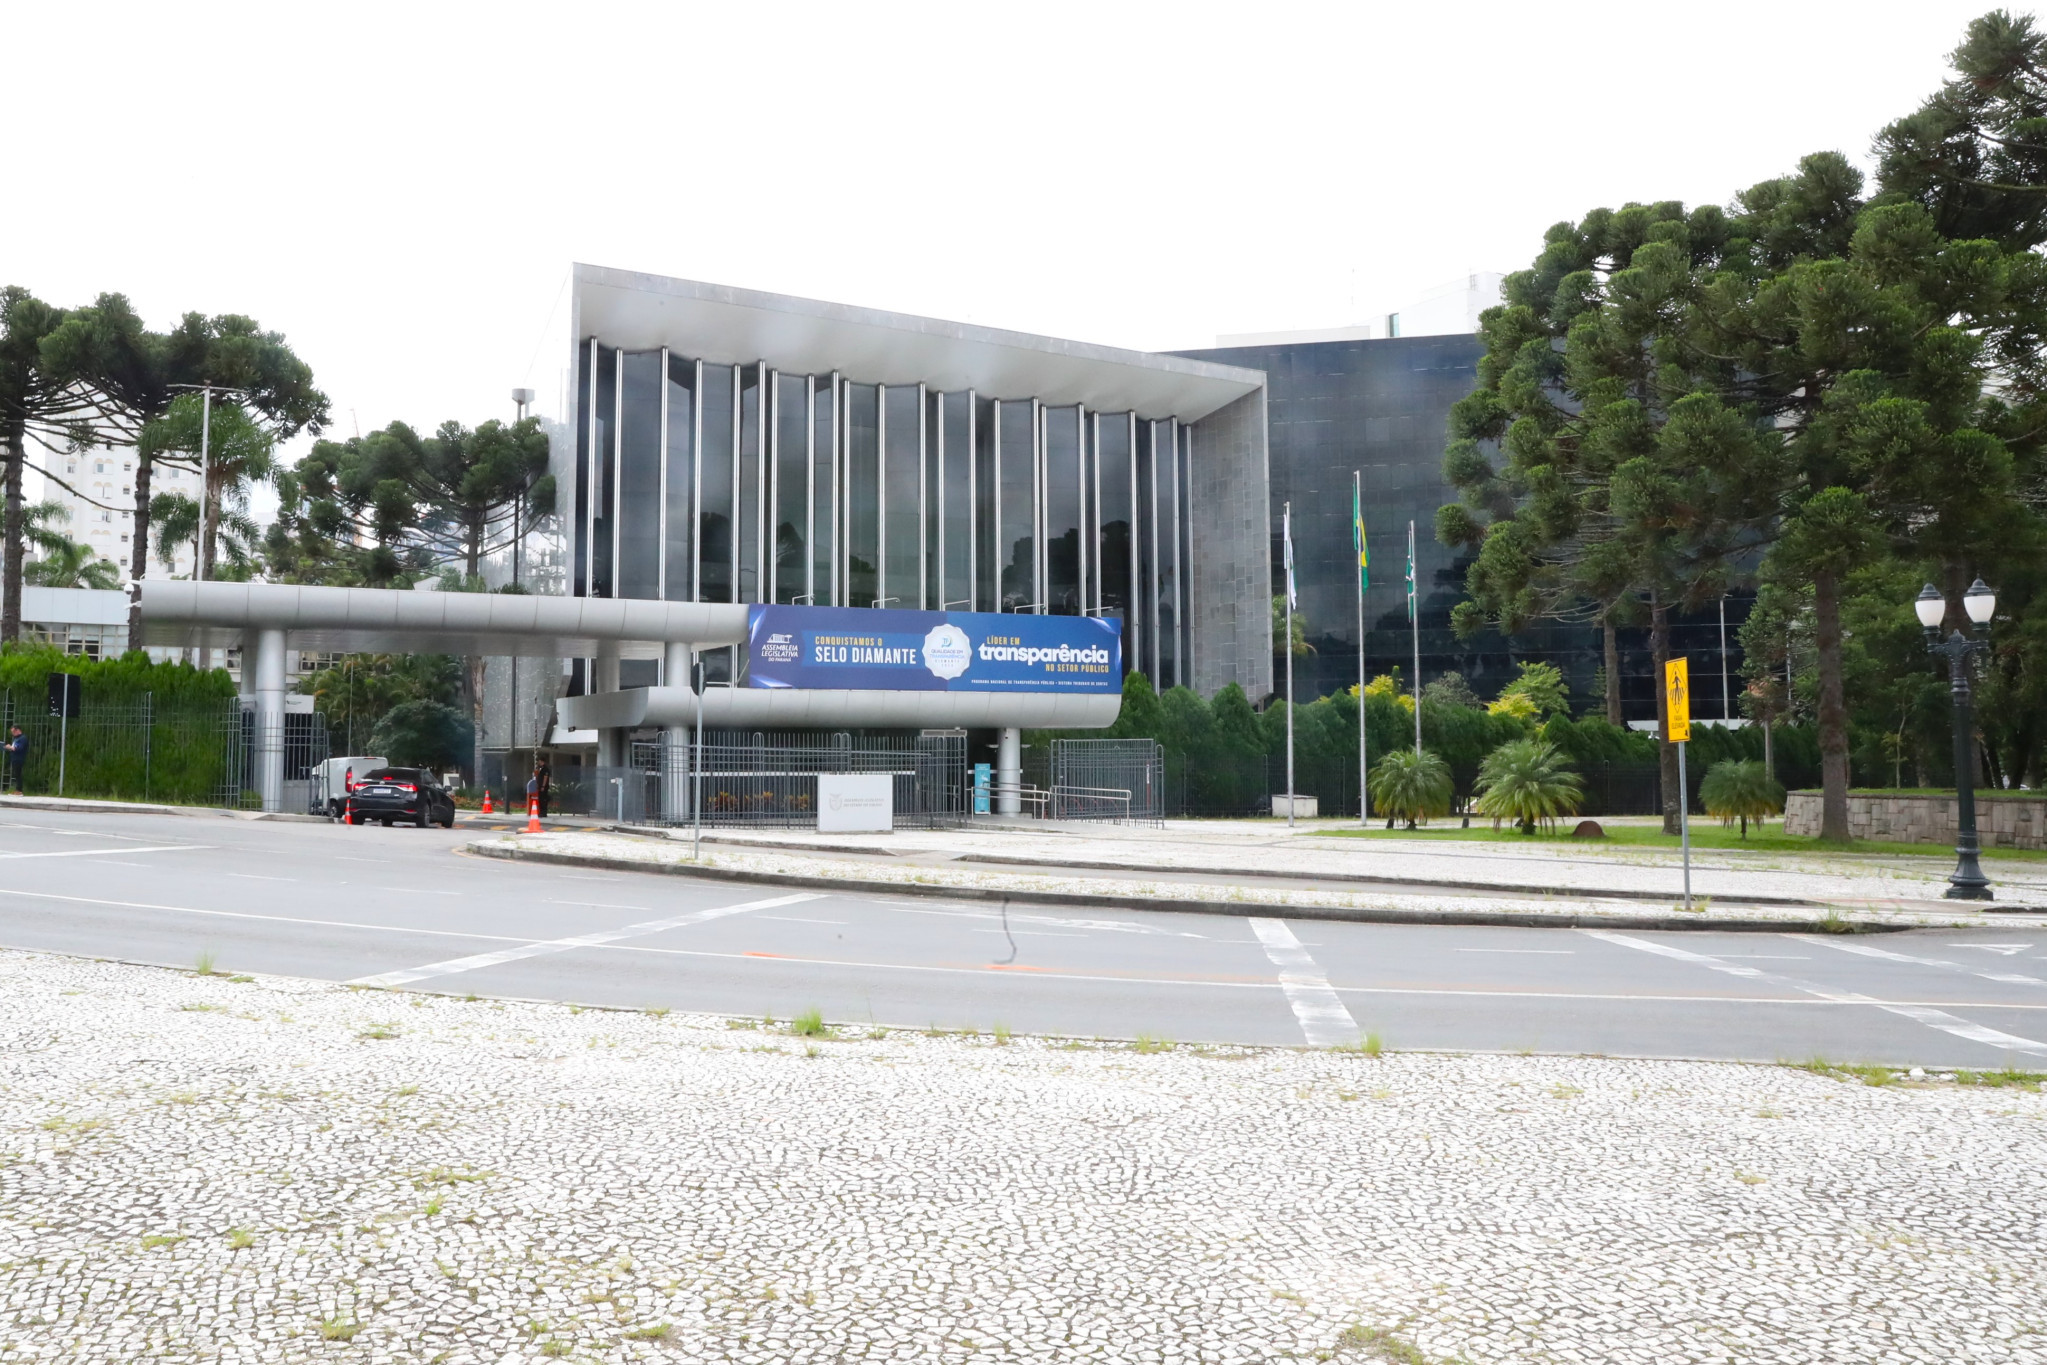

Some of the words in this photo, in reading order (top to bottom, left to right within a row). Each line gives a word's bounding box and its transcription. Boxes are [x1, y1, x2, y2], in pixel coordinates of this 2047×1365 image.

[815, 636, 874, 646] CONQUISTAMOS
[877, 637, 883, 646] O
[986, 635, 1007, 645] LÍDER
[1010, 636, 1020, 645] EM
[815, 646, 847, 663] SELO
[851, 647, 917, 664] DIAMANTE
[978, 642, 1109, 666] transparência
[1045, 663, 1055, 672] NO
[1057, 663, 1079, 672] SETOR
[1081, 663, 1109, 673] PÚBLICO
